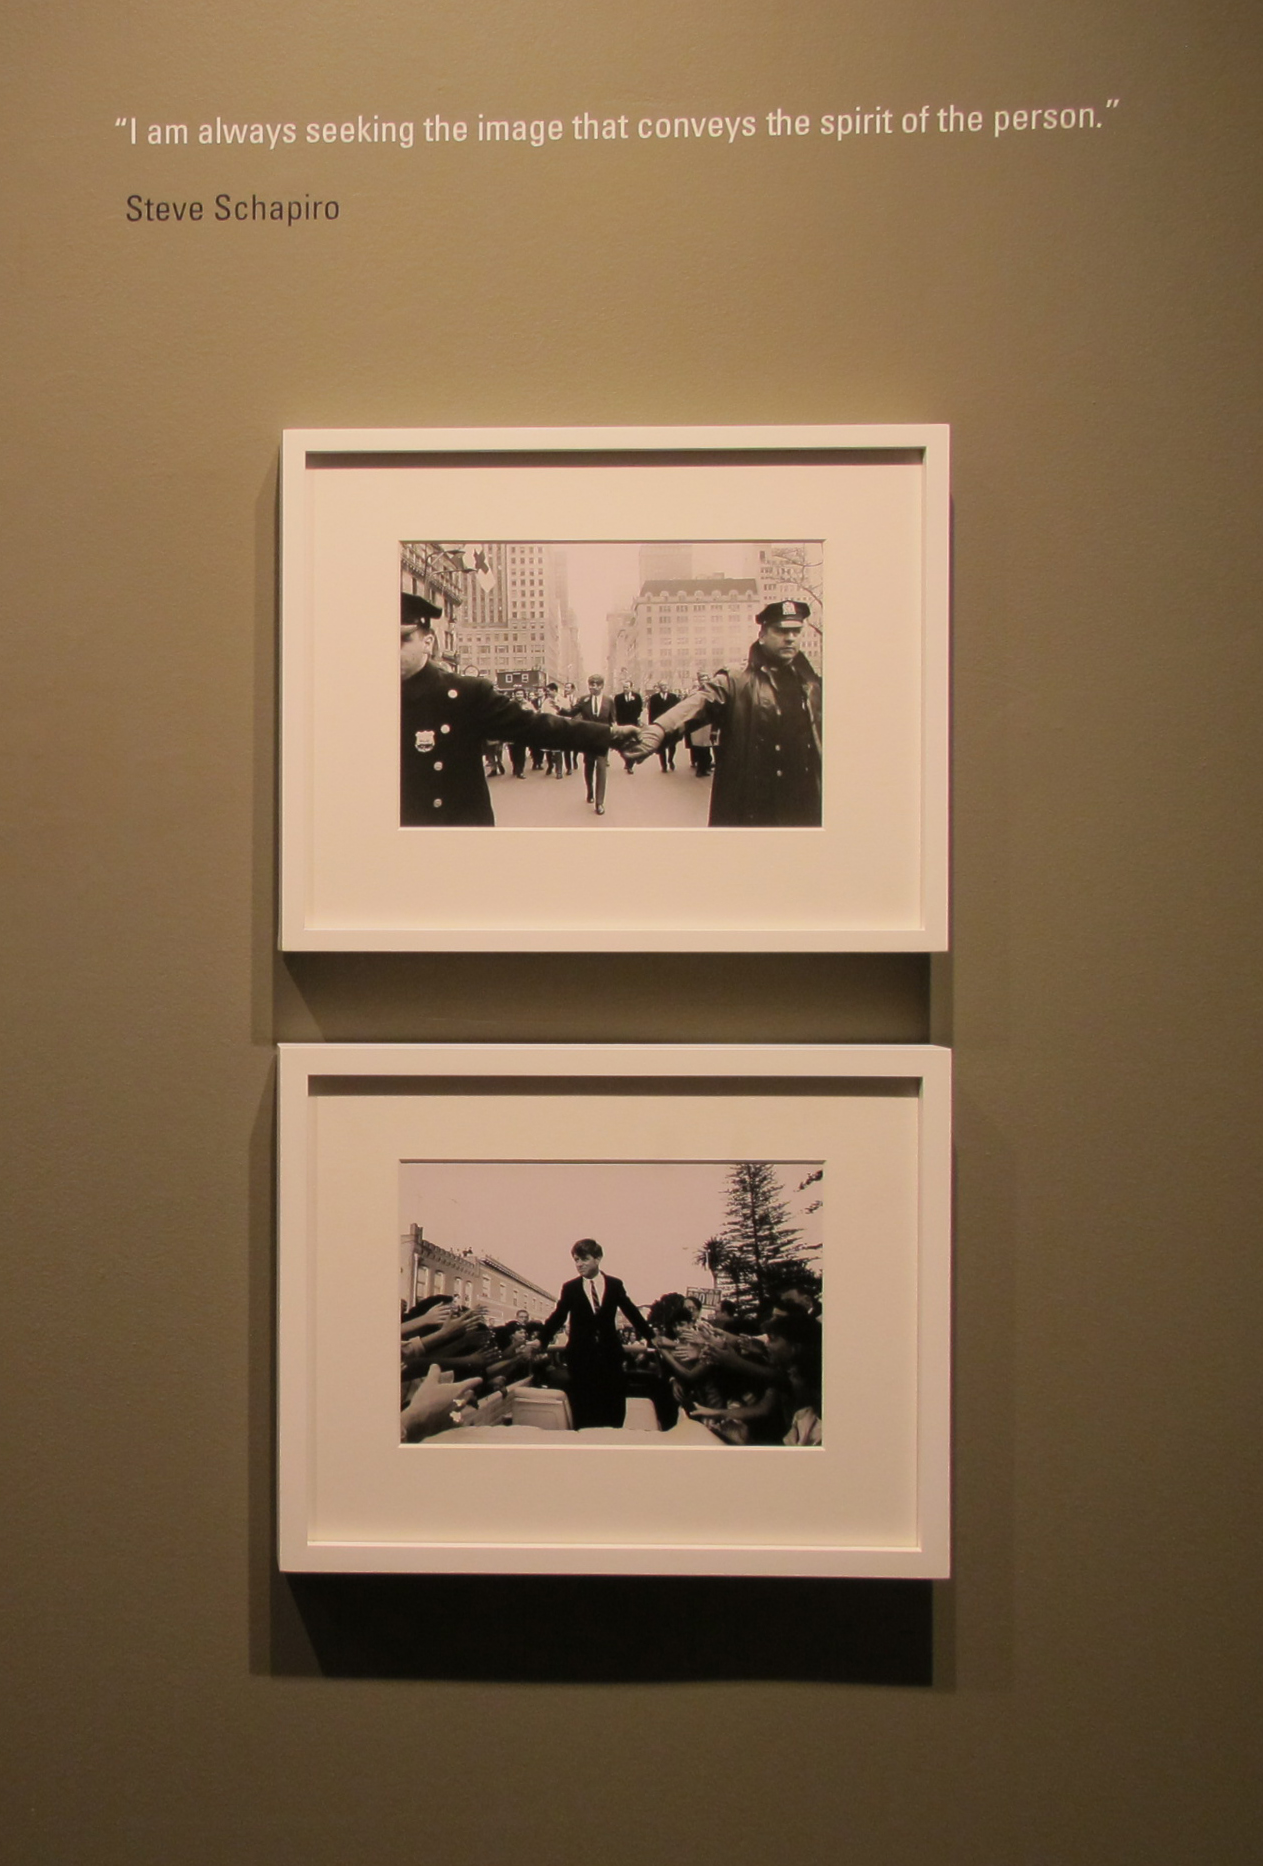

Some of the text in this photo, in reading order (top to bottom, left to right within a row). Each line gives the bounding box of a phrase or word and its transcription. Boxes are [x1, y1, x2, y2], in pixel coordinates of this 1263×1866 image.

[115, 99, 1120, 149] “I am always seeking the image that conveys the spirit of the person.”
[126, 194, 340, 226] Steve Schapiro
